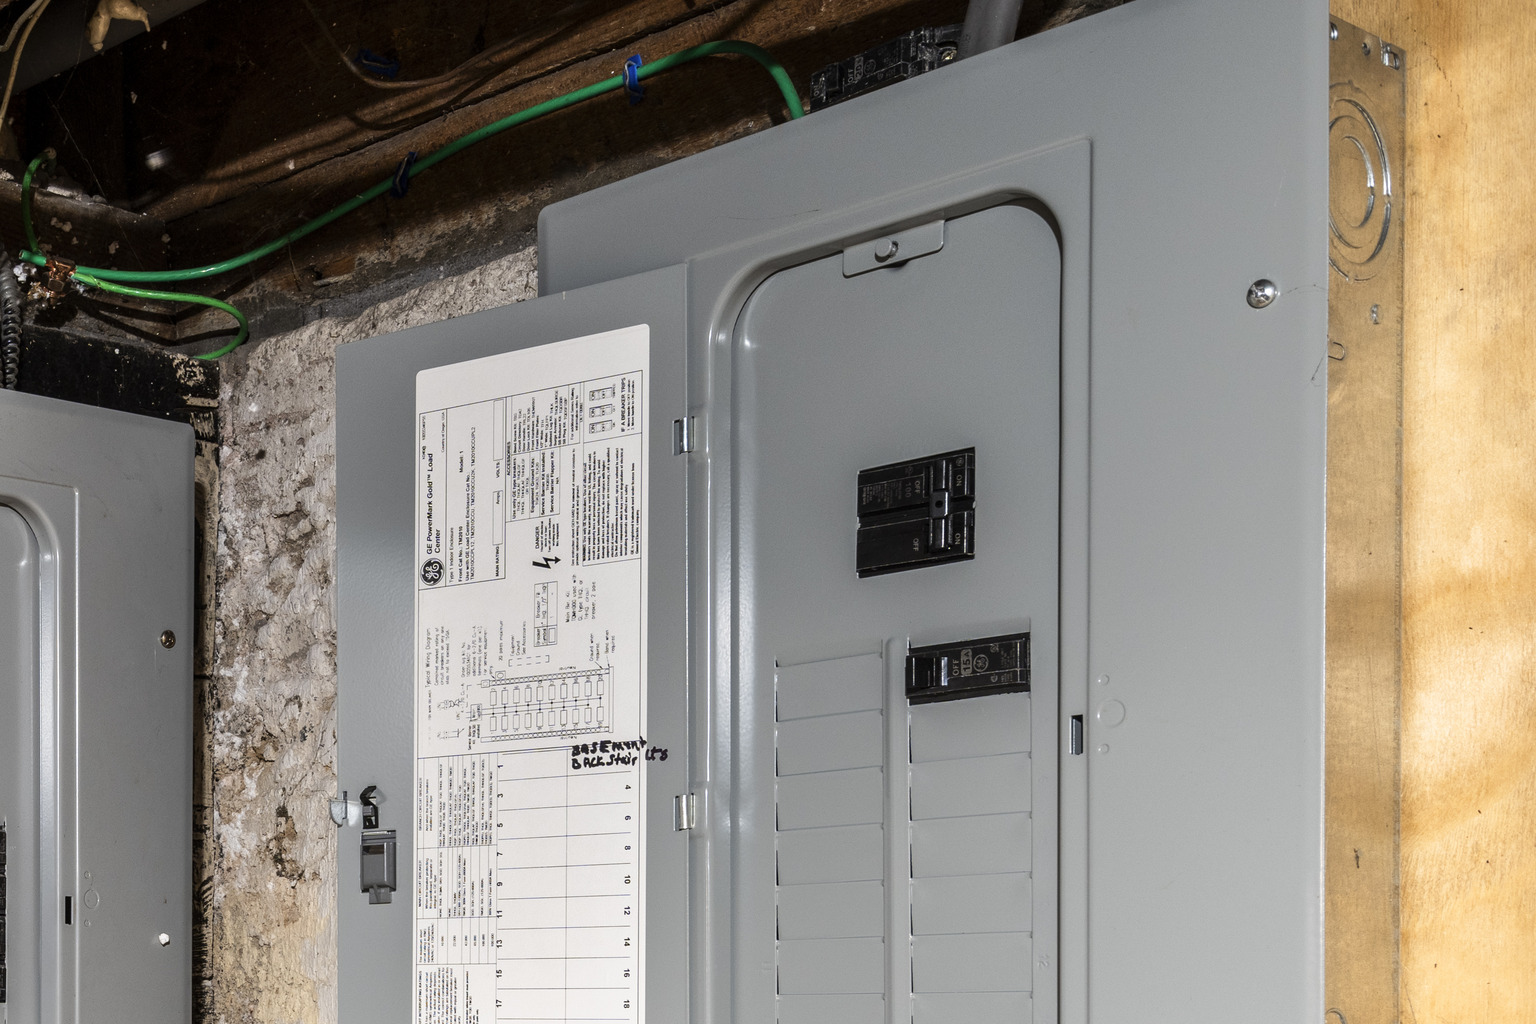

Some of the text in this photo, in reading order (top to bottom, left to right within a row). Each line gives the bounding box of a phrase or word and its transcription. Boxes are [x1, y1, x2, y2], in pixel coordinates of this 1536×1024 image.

[956, 474, 963, 487] ON
[954, 532, 961, 545] ON
[426, 543, 433, 554] GE
